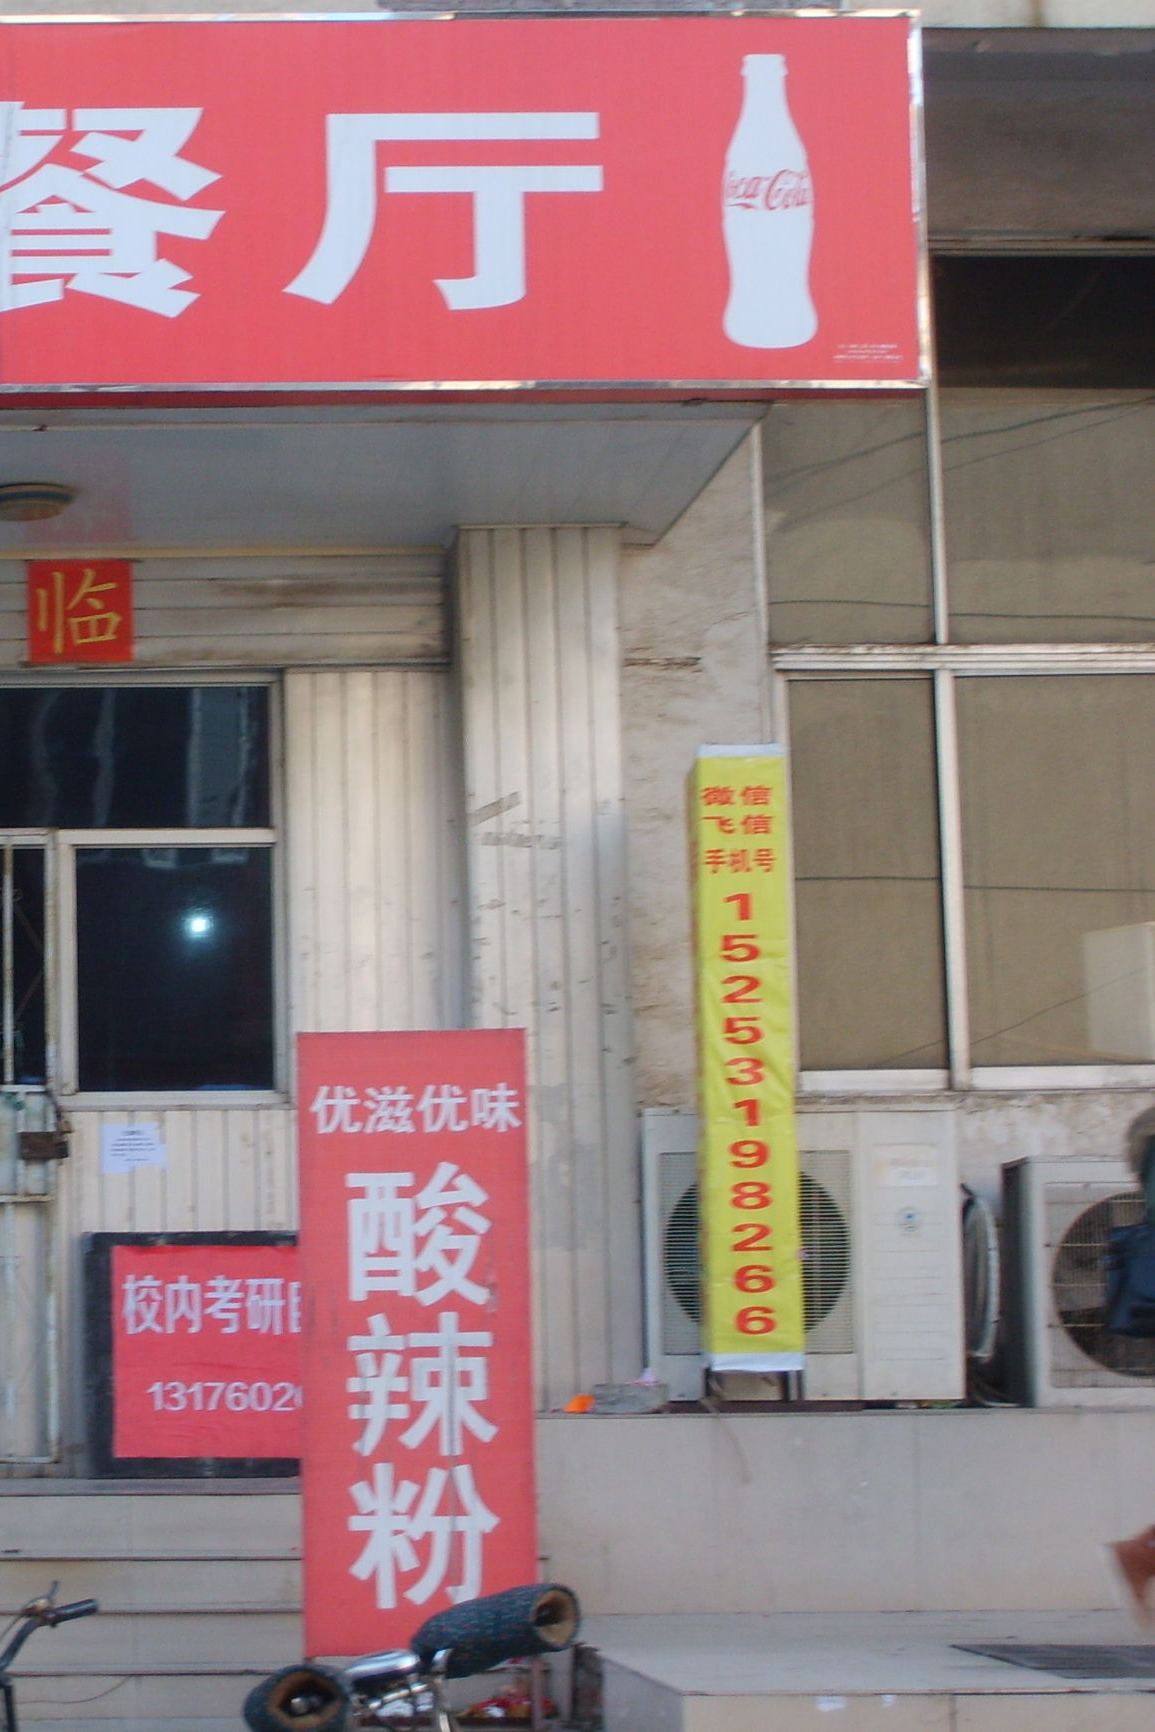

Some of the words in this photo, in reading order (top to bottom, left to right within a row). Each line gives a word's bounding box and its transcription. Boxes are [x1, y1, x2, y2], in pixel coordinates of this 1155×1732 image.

[701, 785, 772, 806] 微信
[701, 814, 773, 835] 飞信
[704, 848, 775, 874] 手机号
[309, 1082, 523, 1134] 优滋优味
[720, 893, 777, 1335] 15253198266
[346, 1162, 499, 1608] 酸辣粉
